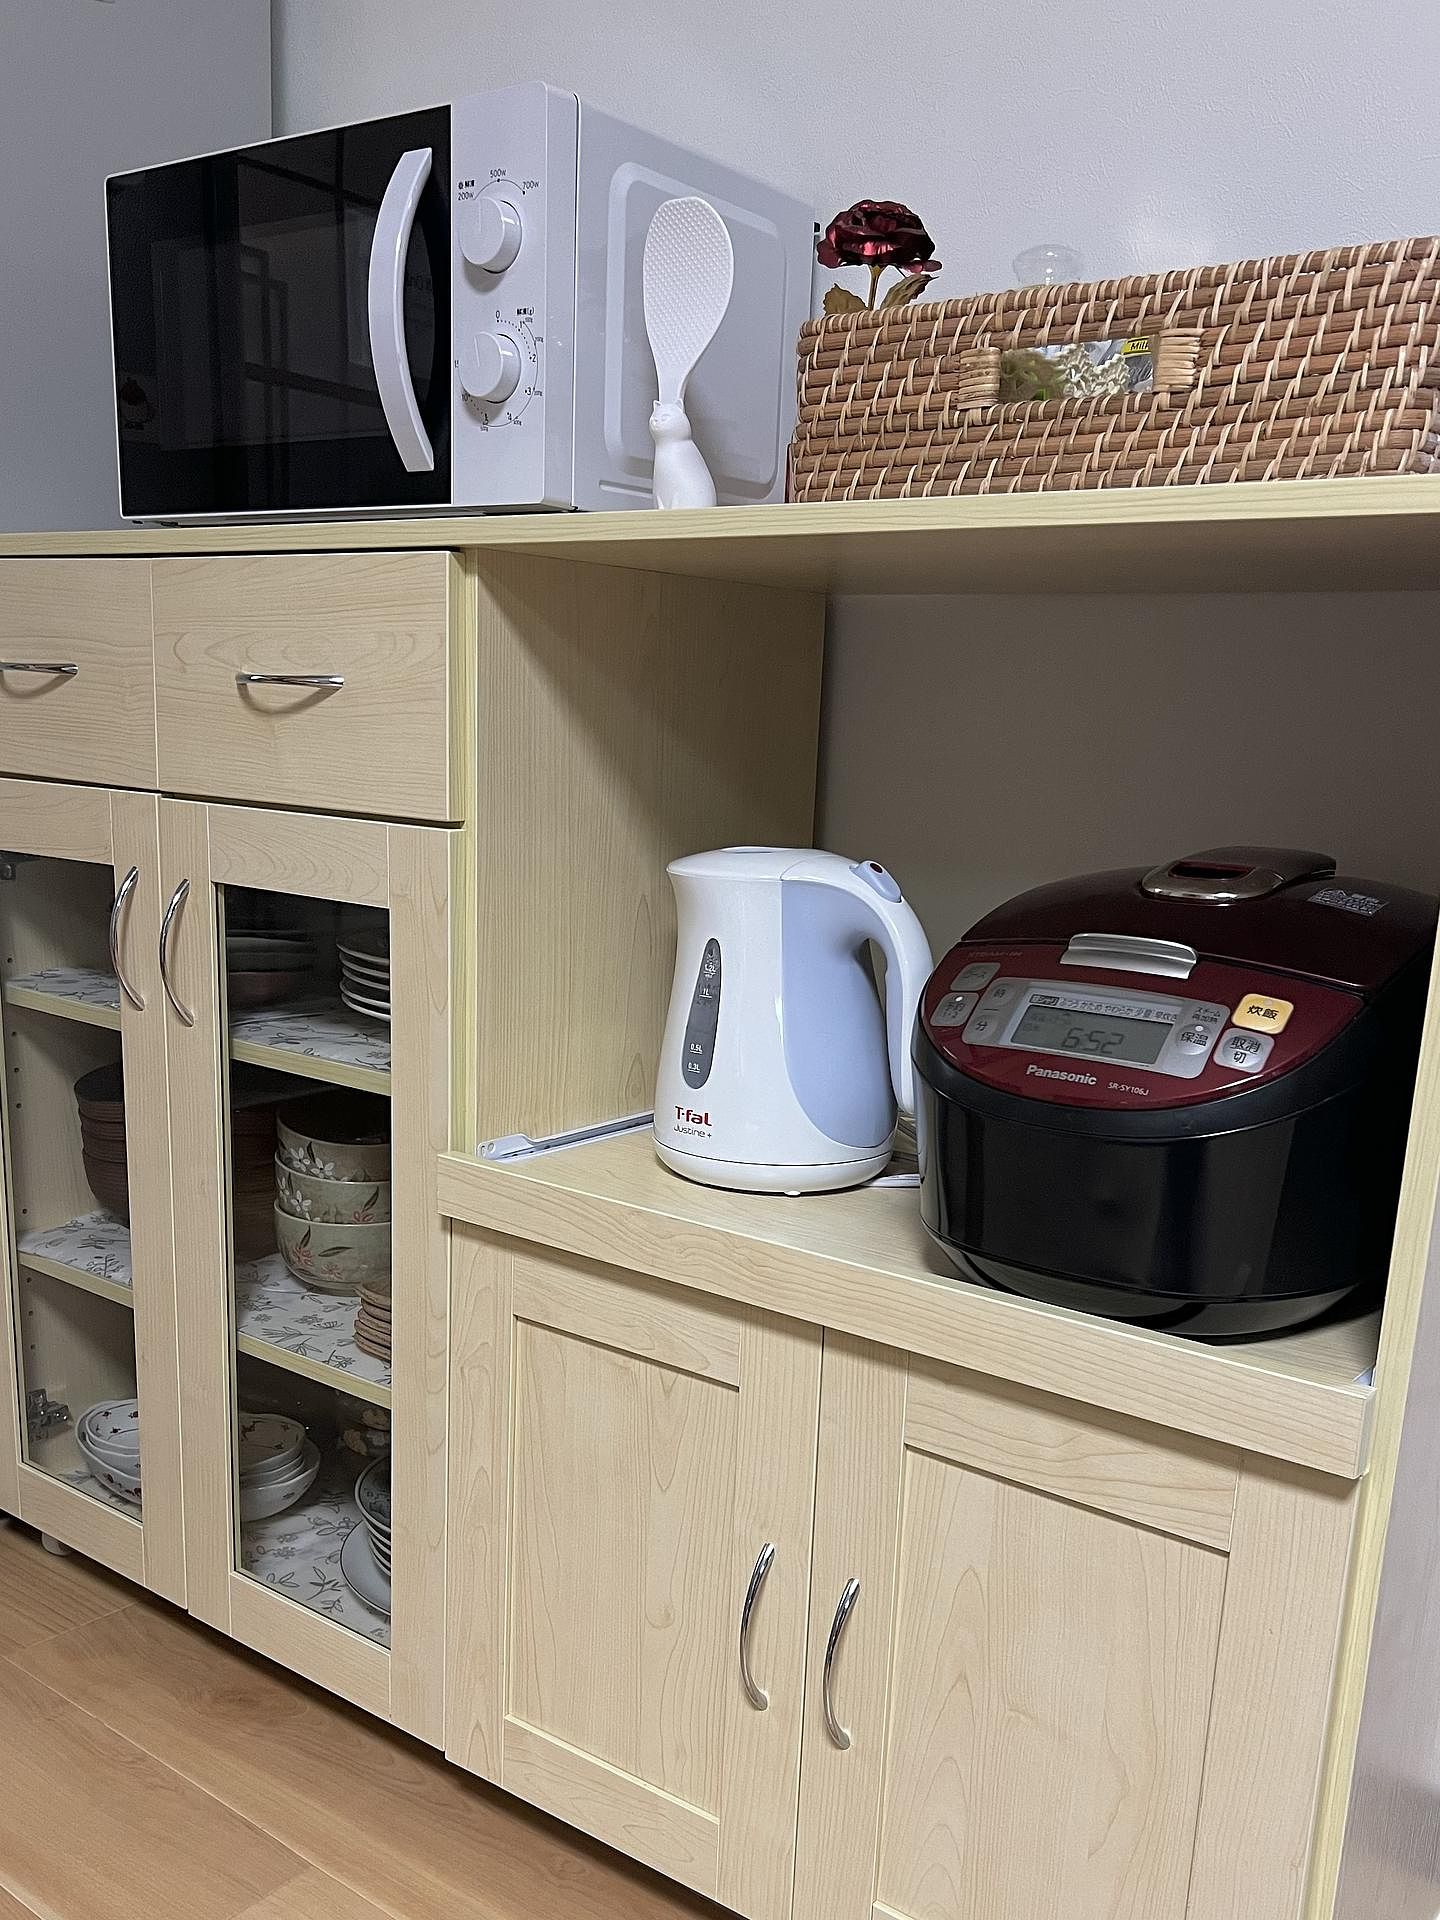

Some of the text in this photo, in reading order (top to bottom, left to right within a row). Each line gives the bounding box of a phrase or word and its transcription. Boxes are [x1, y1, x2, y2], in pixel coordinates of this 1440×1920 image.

[1246, 1004, 1280, 1021] 炊飯
[1180, 1031, 1209, 1047] 保温
[1229, 1036, 1262, 1054] 取消
[1233, 1051, 1247, 1064] 切
[1026, 1064, 1150, 1096] Panasonic SR-SY106J
[673, 1124, 705, 1138] Justine
